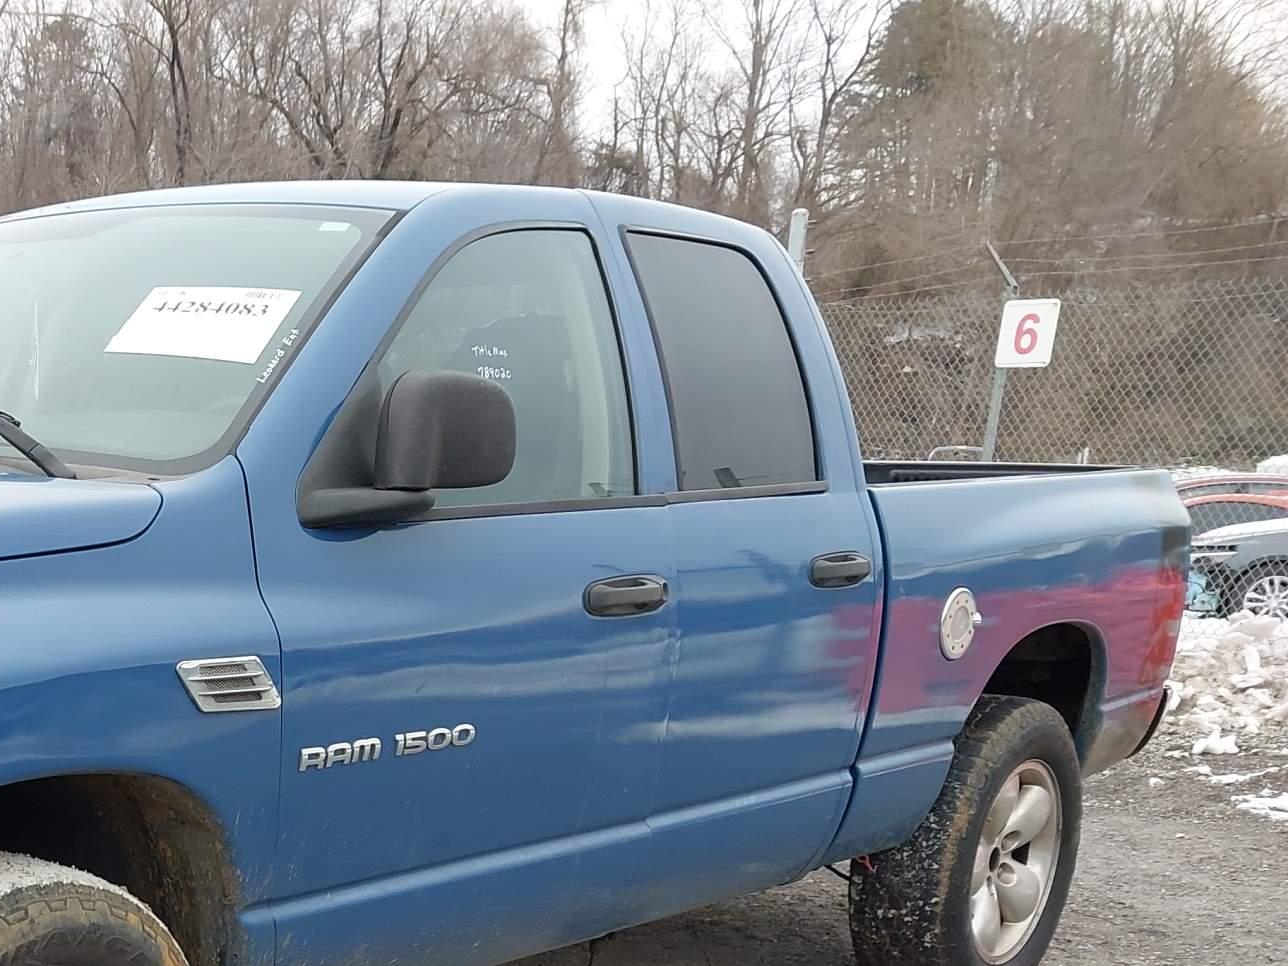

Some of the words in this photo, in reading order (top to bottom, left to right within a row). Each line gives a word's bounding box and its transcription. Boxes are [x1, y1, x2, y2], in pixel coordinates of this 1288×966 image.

[153, 301, 269, 317] 44284083
[1014, 313, 1040, 355] 6
[298, 737, 381, 772] RAM
[394, 723, 476, 757] 1500
